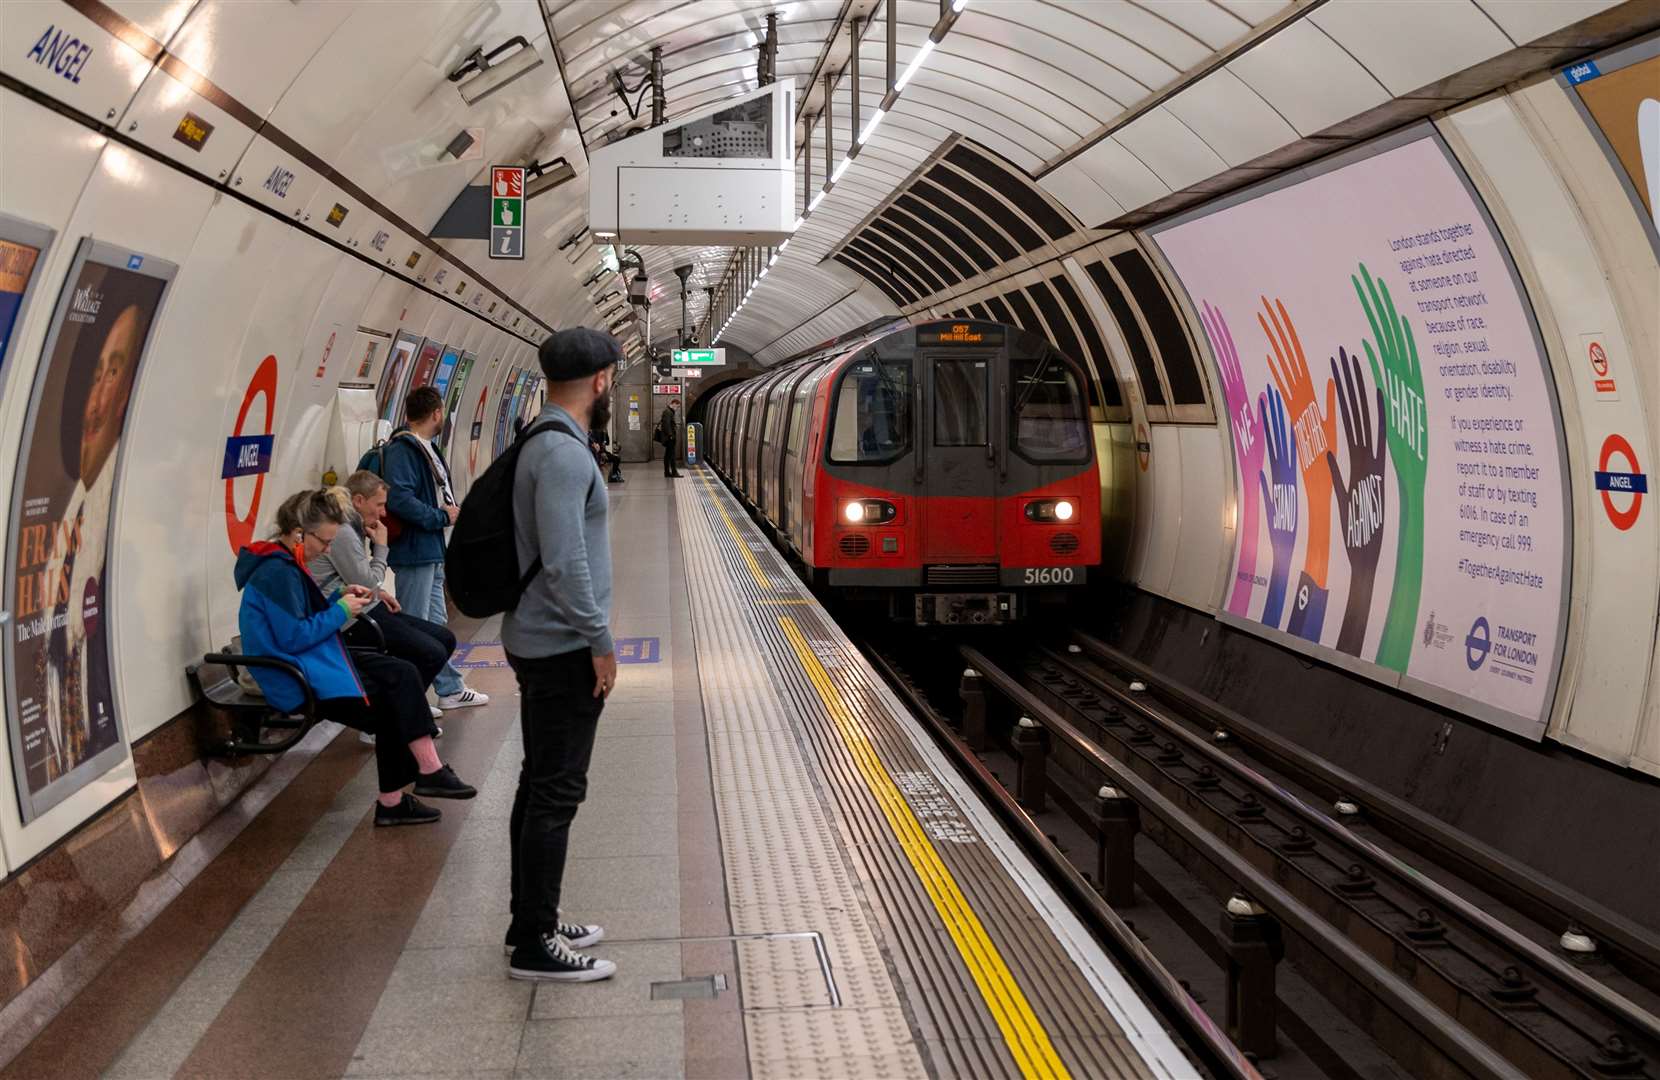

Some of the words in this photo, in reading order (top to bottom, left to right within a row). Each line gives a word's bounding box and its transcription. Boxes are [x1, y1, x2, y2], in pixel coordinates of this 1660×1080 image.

[27, 25, 93, 84] ANGEL
[1570, 63, 1591, 82] global
[263, 165, 295, 198] ANGEL
[1388, 235, 1416, 251] London
[1416, 229, 1441, 246] stands
[1439, 222, 1473, 242] together
[1400, 256, 1426, 274] against
[1423, 253, 1443, 266] hate
[1442, 244, 1476, 263] directed
[1409, 280, 1419, 292] at
[1417, 276, 1453, 291] someone
[1452, 273, 1464, 286] on
[1464, 271, 1479, 284] our
[1417, 297, 1454, 314] transport
[1454, 291, 1488, 308] network
[1424, 320, 1457, 334] because
[1457, 315, 1465, 331] of
[964, 333, 981, 341] East
[1463, 336, 1490, 353] sexual
[1481, 360, 1516, 377] disability
[1444, 387, 1452, 399] or
[1454, 384, 1479, 402] gender
[1479, 383, 1513, 401] identity.
[1387, 368, 1425, 461] HATE
[1450, 415, 1456, 429] If
[1457, 419, 1471, 433] you
[1472, 417, 1513, 433] experience
[1514, 419, 1523, 431] or
[1236, 402, 1254, 456] WE
[1294, 400, 1328, 472] TOGETHER
[237, 443, 259, 468] ANGEL
[1455, 439, 1482, 453] witness
[1483, 442, 1489, 453] a
[1489, 439, 1507, 454] hate
[1456, 462, 1480, 477] report
[1481, 462, 1488, 476] it
[1488, 464, 1498, 477] to
[1499, 465, 1504, 477] a
[1505, 464, 1540, 480] member
[1609, 475, 1632, 489] ANGEL
[1459, 481, 1466, 497] of
[1468, 483, 1485, 498] staff
[1487, 487, 1495, 500] or
[1497, 485, 1506, 504] by
[1508, 488, 1537, 508] texting
[1273, 483, 1296, 533] STAND
[1347, 473, 1382, 548] AGAINST
[1480, 506, 1488, 521] In
[1490, 511, 1506, 525] case
[1508, 510, 1517, 526] of
[1519, 514, 1529, 527] an
[21, 517, 83, 568] FRANS
[1460, 530, 1500, 550] emergency
[1501, 533, 1516, 550] call
[1517, 534, 1533, 552] 999.
[1024, 567, 1074, 584] 51600
[1458, 558, 1544, 589] #TogetherAgainstHate
[17, 564, 70, 618] HALS
[17, 623, 31, 642] The
[1497, 625, 1536, 647] TRANSPORT
[1493, 642, 1507, 658] FOR
[1507, 646, 1537, 667] LONDON
